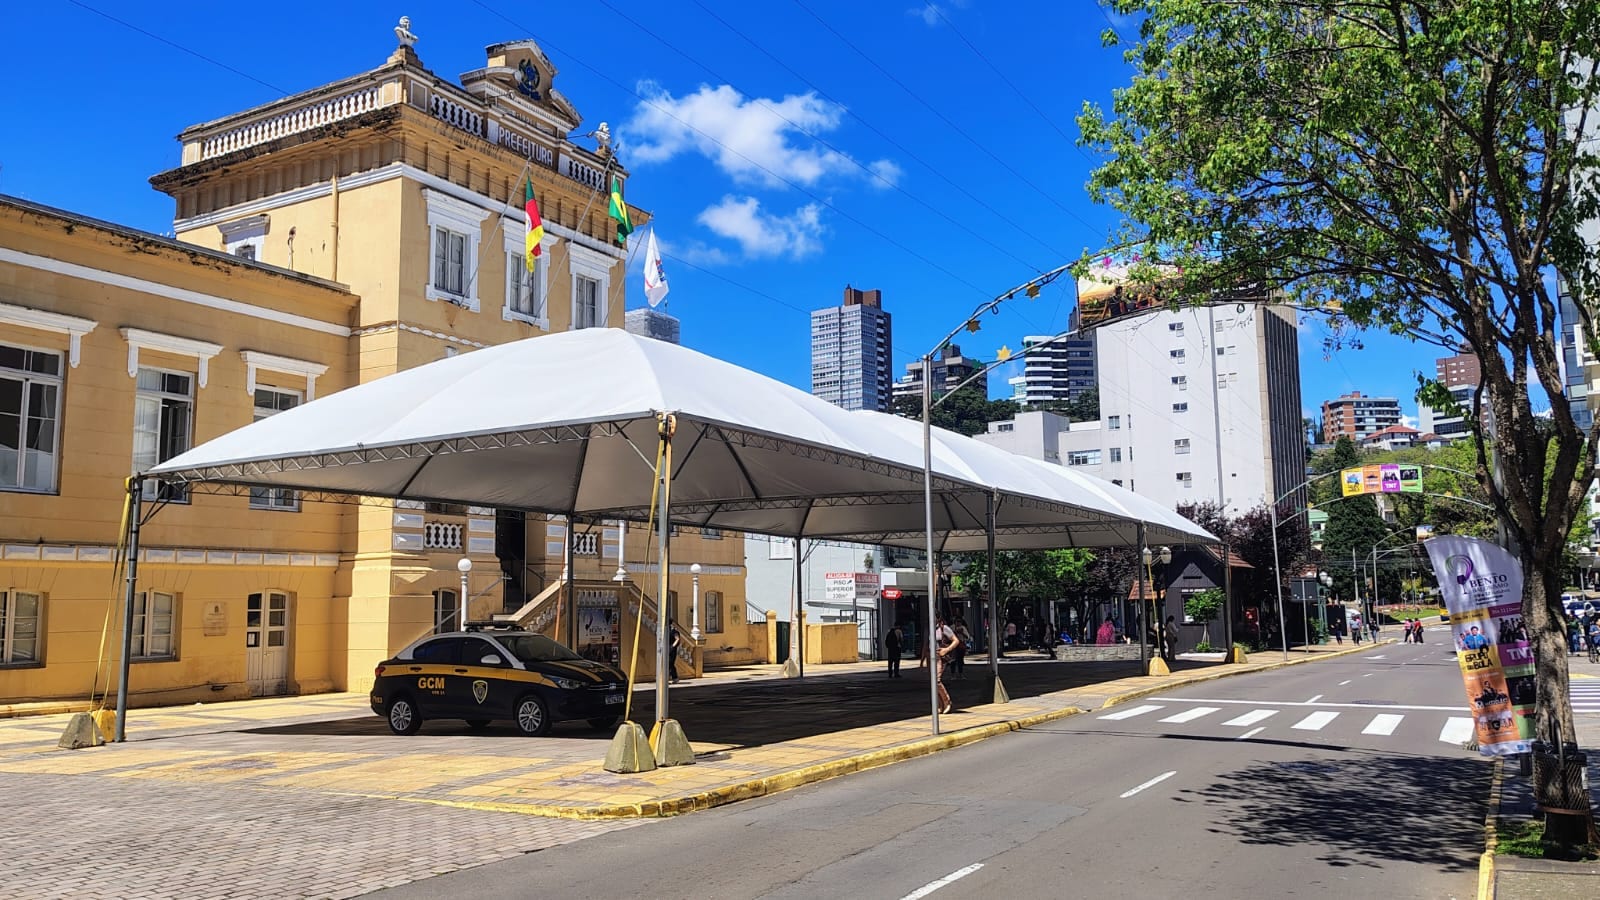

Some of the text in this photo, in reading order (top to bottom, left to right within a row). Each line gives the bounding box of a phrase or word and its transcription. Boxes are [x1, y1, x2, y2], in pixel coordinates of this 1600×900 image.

[499, 126, 553, 167] PREFEITURA
[1469, 574, 1508, 588] BENTO
[1473, 658, 1493, 670] BOLA
[418, 677, 445, 689] GCM
